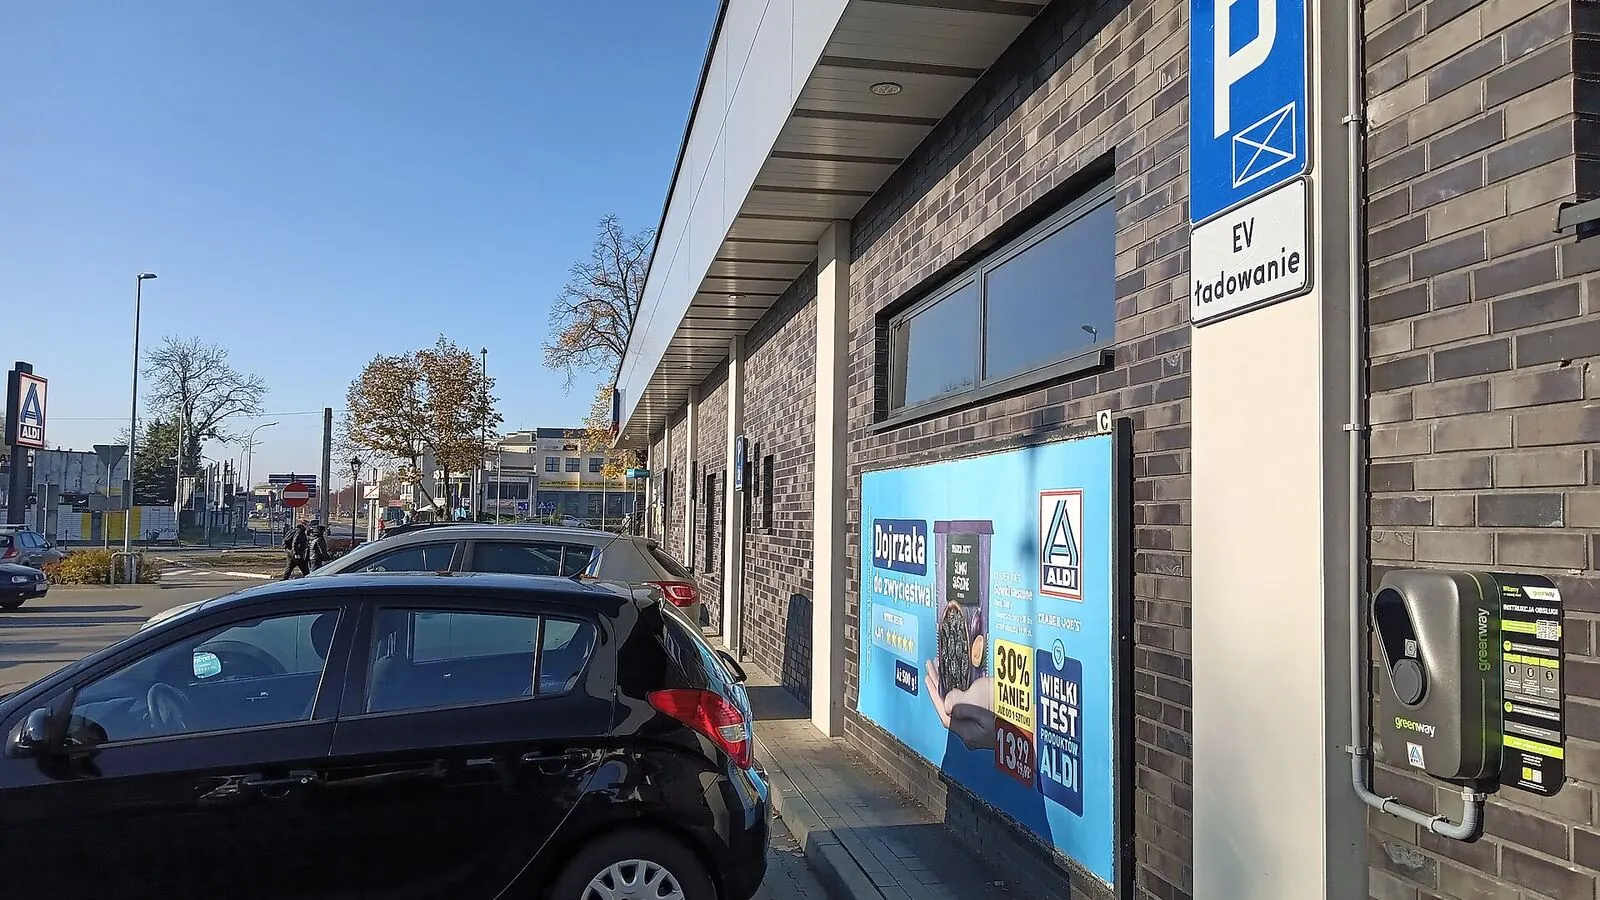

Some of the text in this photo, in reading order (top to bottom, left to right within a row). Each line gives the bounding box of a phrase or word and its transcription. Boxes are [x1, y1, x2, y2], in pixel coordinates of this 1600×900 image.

[1214, 0, 1277, 139] P
[1233, 217, 1255, 253] EV
[1194, 247, 1300, 307] ładowanie
[21, 425, 41, 440] ALDI
[1101, 412, 1109, 431] C
[875, 524, 926, 568] Dojrzała
[873, 571, 934, 608] do zwycięstwa!
[1046, 567, 1075, 588] ALDI
[1037, 612, 1061, 628] TRADER
[1478, 607, 1490, 671] greenway
[997, 645, 1030, 687] 30%
[997, 682, 1030, 712] TANIEJ
[1040, 672, 1077, 706] WIELKI
[1040, 695, 1078, 738] TEST
[1395, 717, 1436, 737] greenway
[1040, 727, 1079, 756] PRODUKTÓW
[1040, 744, 1078, 793] ALDI
